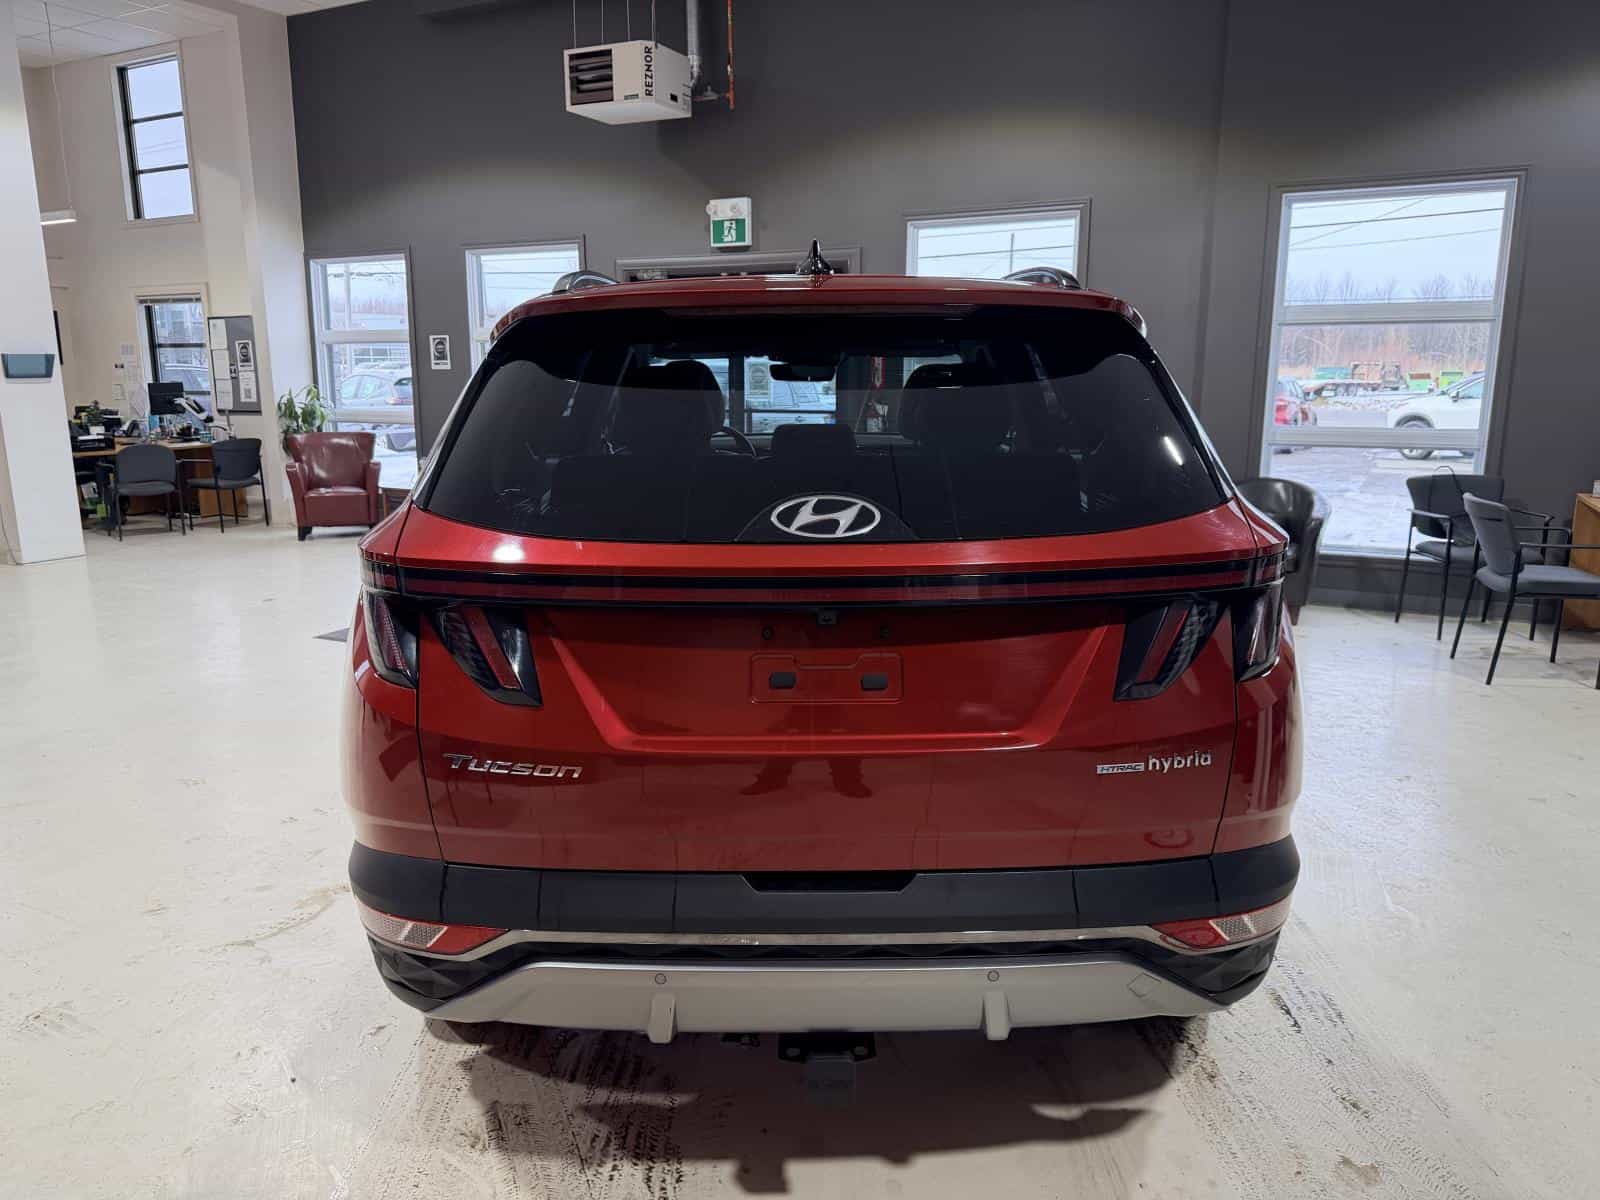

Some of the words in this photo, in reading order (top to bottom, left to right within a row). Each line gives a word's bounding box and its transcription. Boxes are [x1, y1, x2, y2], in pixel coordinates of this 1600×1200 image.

[644, 46, 653, 97] REZNOR
[1099, 763, 1142, 773] HTRAC
[1148, 750, 1212, 773] hybrid
